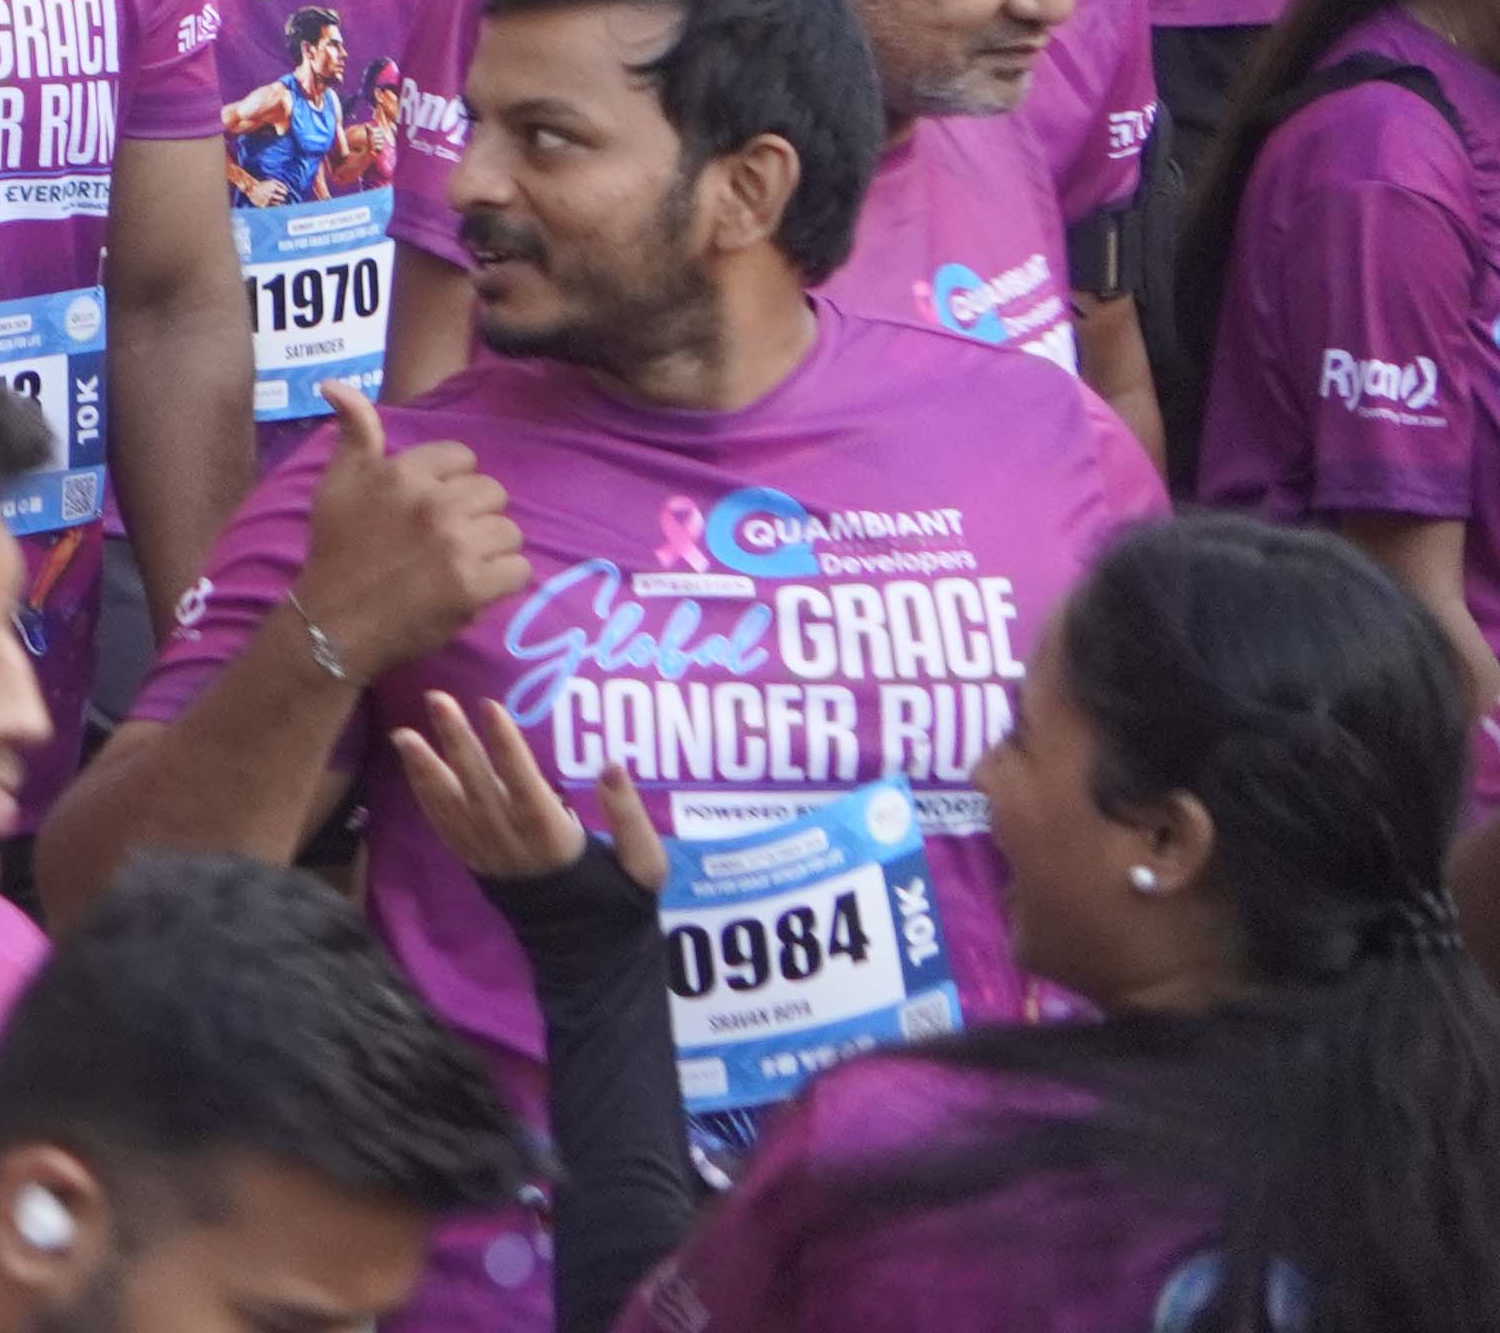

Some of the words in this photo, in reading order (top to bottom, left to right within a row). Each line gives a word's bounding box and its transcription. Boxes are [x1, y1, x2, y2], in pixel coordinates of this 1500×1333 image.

[40, 79, 118, 169] RUN
[284, 338, 346, 361] SATWINDER
[76, 374, 100, 446] 10K
[743, 507, 964, 553] QUAMBIANT
[820, 548, 978, 580] Developers
[505, 558, 772, 725] Global
[777, 576, 1025, 679] GRACE
[553, 679, 858, 783] CANCER
[667, 891, 871, 1000] 0984
[893, 876, 940, 968] 10K
